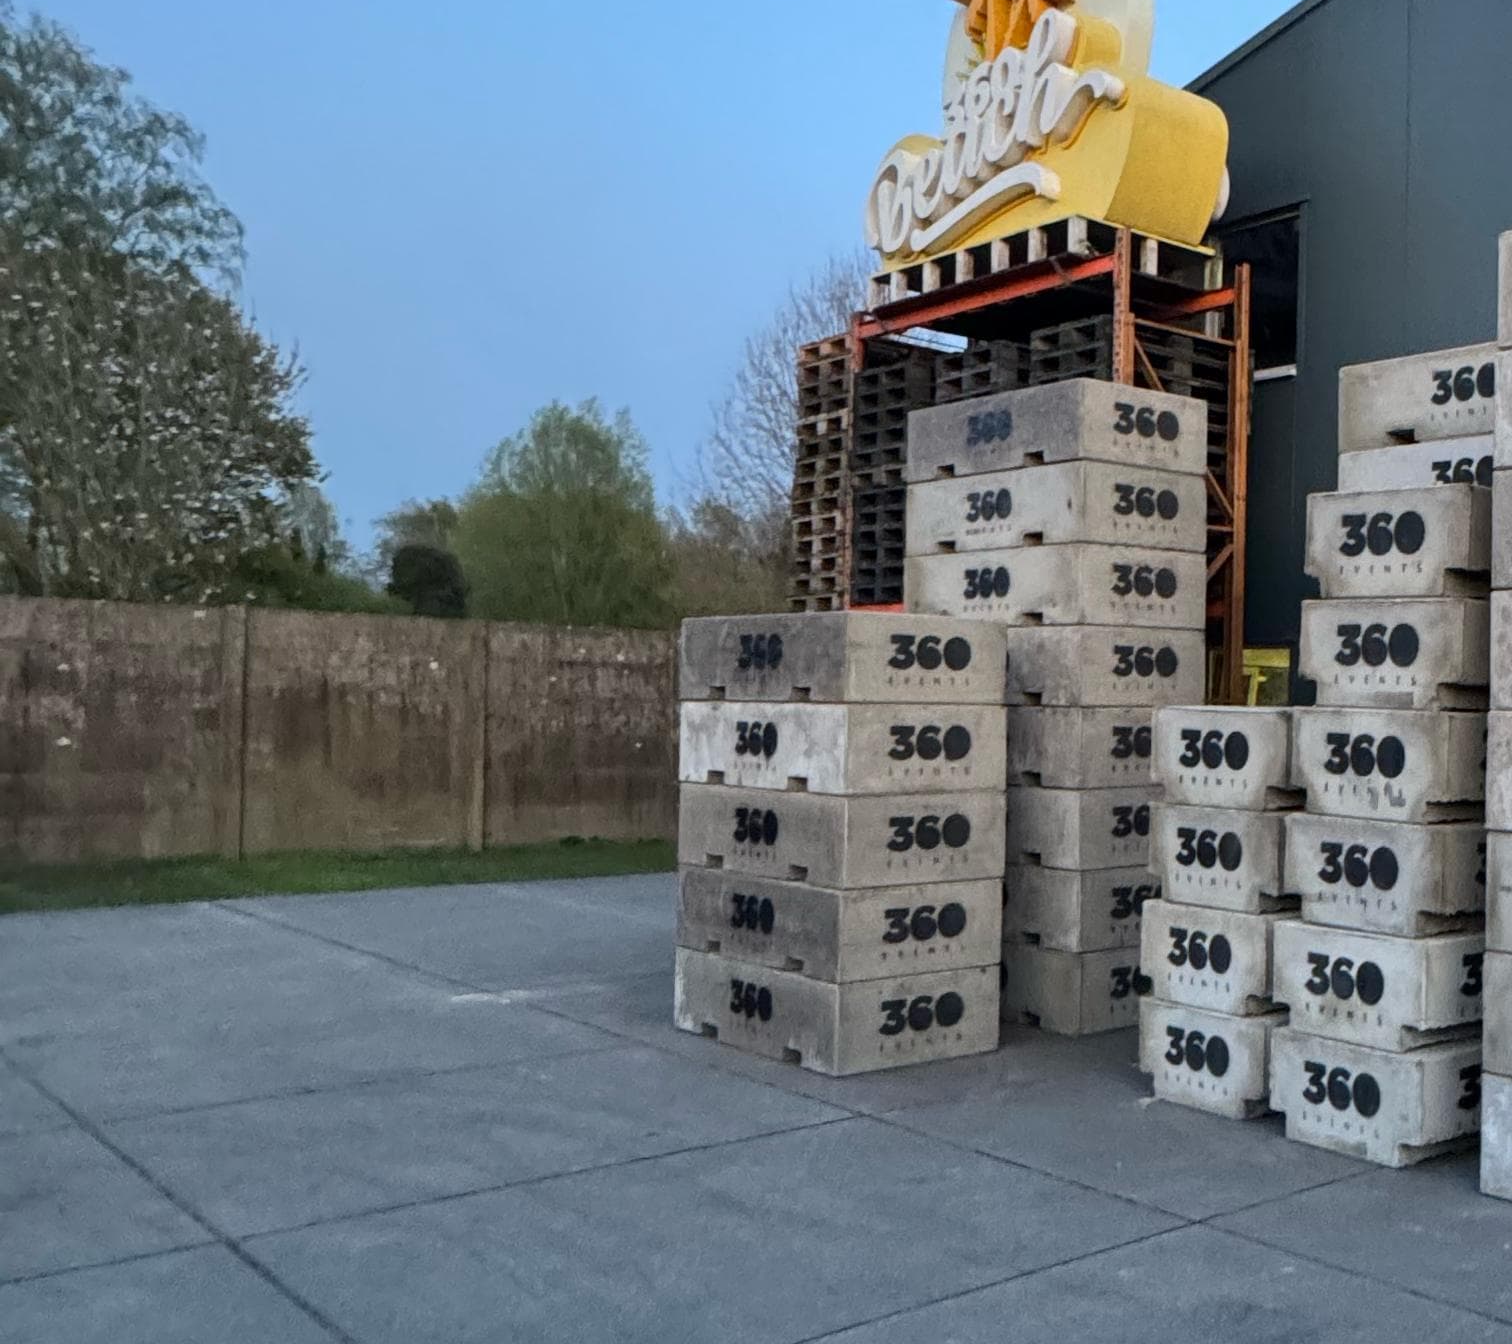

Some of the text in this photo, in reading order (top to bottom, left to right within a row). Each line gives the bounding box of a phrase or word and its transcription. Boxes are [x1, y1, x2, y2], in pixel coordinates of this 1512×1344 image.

[868, 8, 1126, 253] Beach
[1113, 402, 1179, 441] 360
[966, 488, 1012, 522] 360
[1113, 484, 1179, 520] 360
[1339, 511, 1425, 556] 360
[964, 567, 1010, 599] 360
[1111, 564, 1176, 598] 360
[1340, 562, 1423, 575] EVENTS
[889, 634, 971, 670] 360
[1112, 645, 1178, 677] 360
[1335, 624, 1419, 667] 360
[1335, 673, 1417, 686] EVENTS
[889, 726, 971, 760] 360
[1111, 726, 1151, 758] 36
[1179, 729, 1249, 771] 360
[1324, 733, 1405, 778] 360
[887, 814, 970, 851] 360
[1112, 805, 1150, 838] 36
[1176, 827, 1242, 872] 360
[1318, 842, 1398, 891] 360
[1110, 884, 1161, 918] 36
[883, 903, 966, 944] 360
[1168, 927, 1231, 974] 360
[1110, 966, 1153, 998] 36
[1305, 952, 1384, 1005] 360
[879, 992, 964, 1036] 360
[1165, 1025, 1229, 1077] 360
[1303, 1061, 1380, 1118] 360
